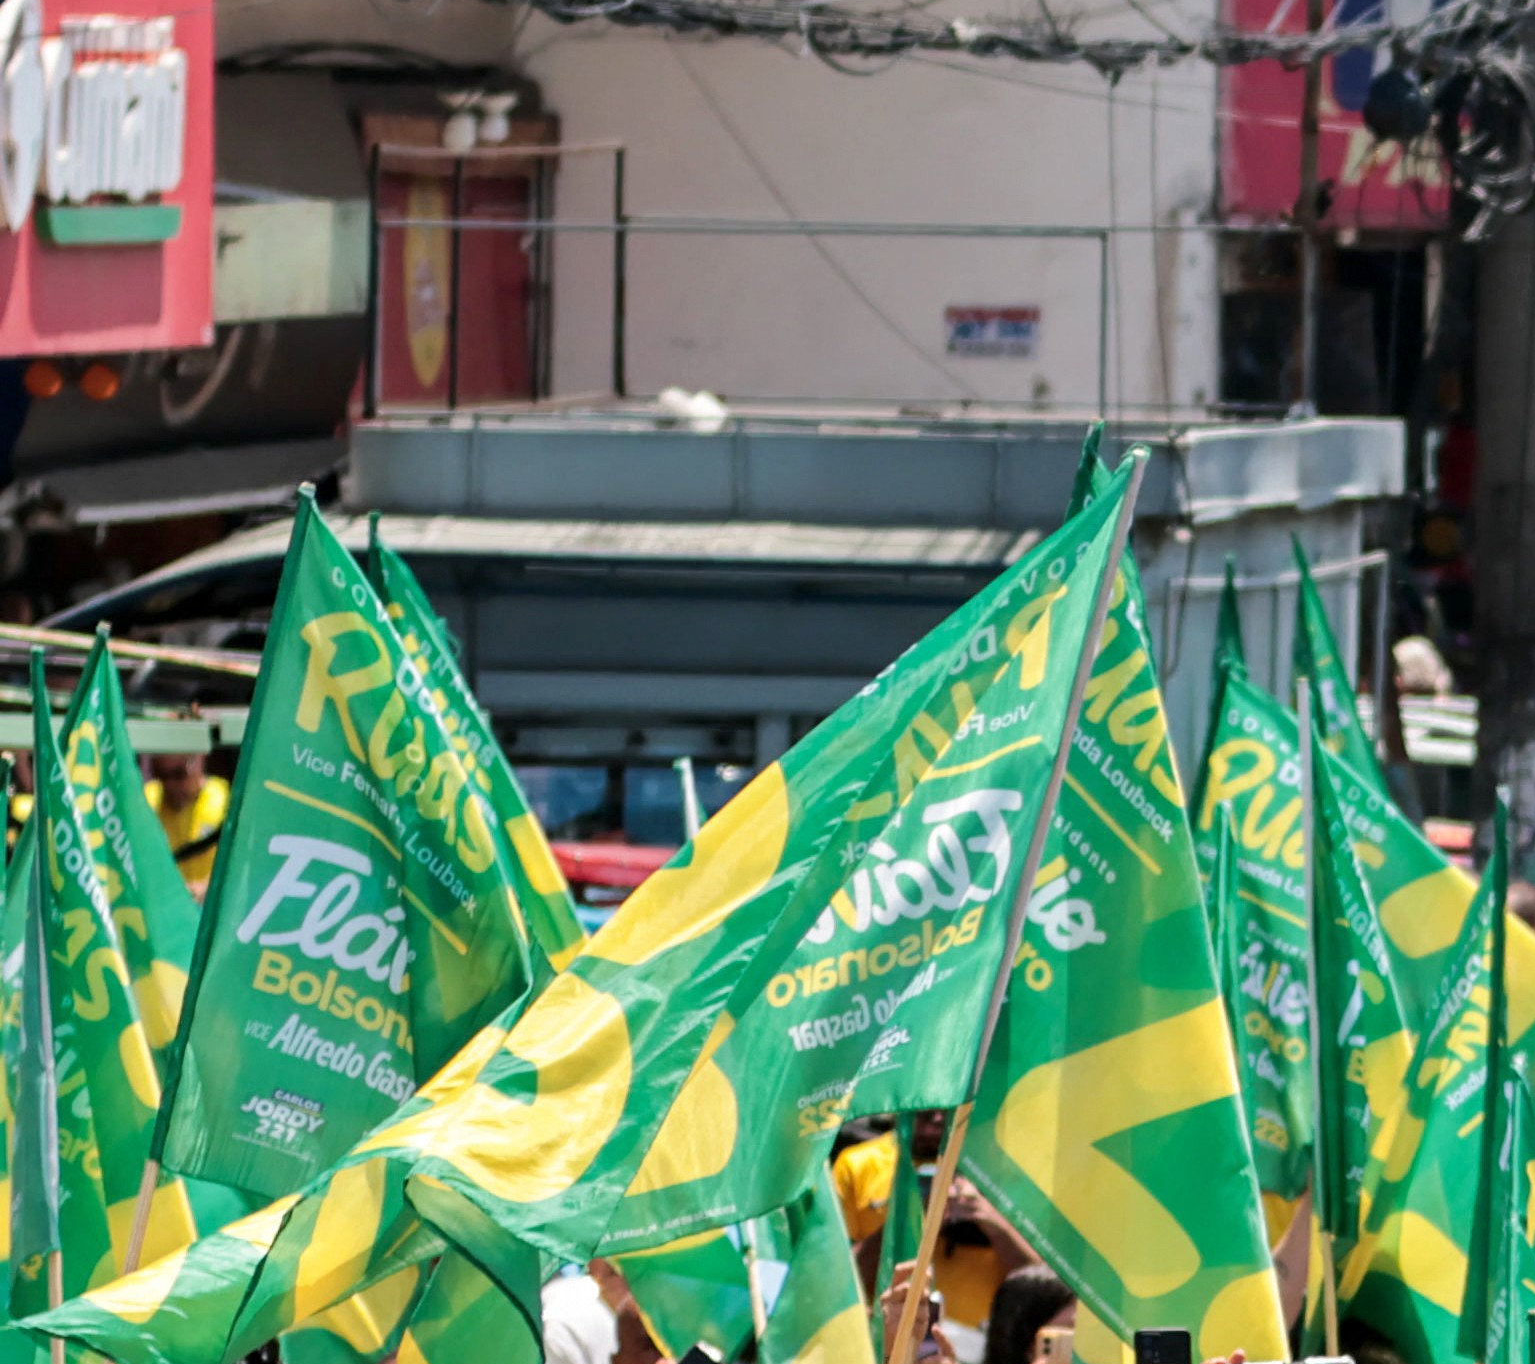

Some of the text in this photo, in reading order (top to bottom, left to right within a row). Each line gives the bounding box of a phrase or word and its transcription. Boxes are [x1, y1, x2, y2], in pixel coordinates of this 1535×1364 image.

[292, 742, 337, 778] Vice
[404, 831, 478, 919] Louback
[1100, 755, 1174, 844] Louback
[1053, 814, 1118, 885] sidente
[253, 948, 414, 1056] Bolson
[267, 1013, 366, 1080] Alfredo
[240, 1094, 325, 1134] JORDY
